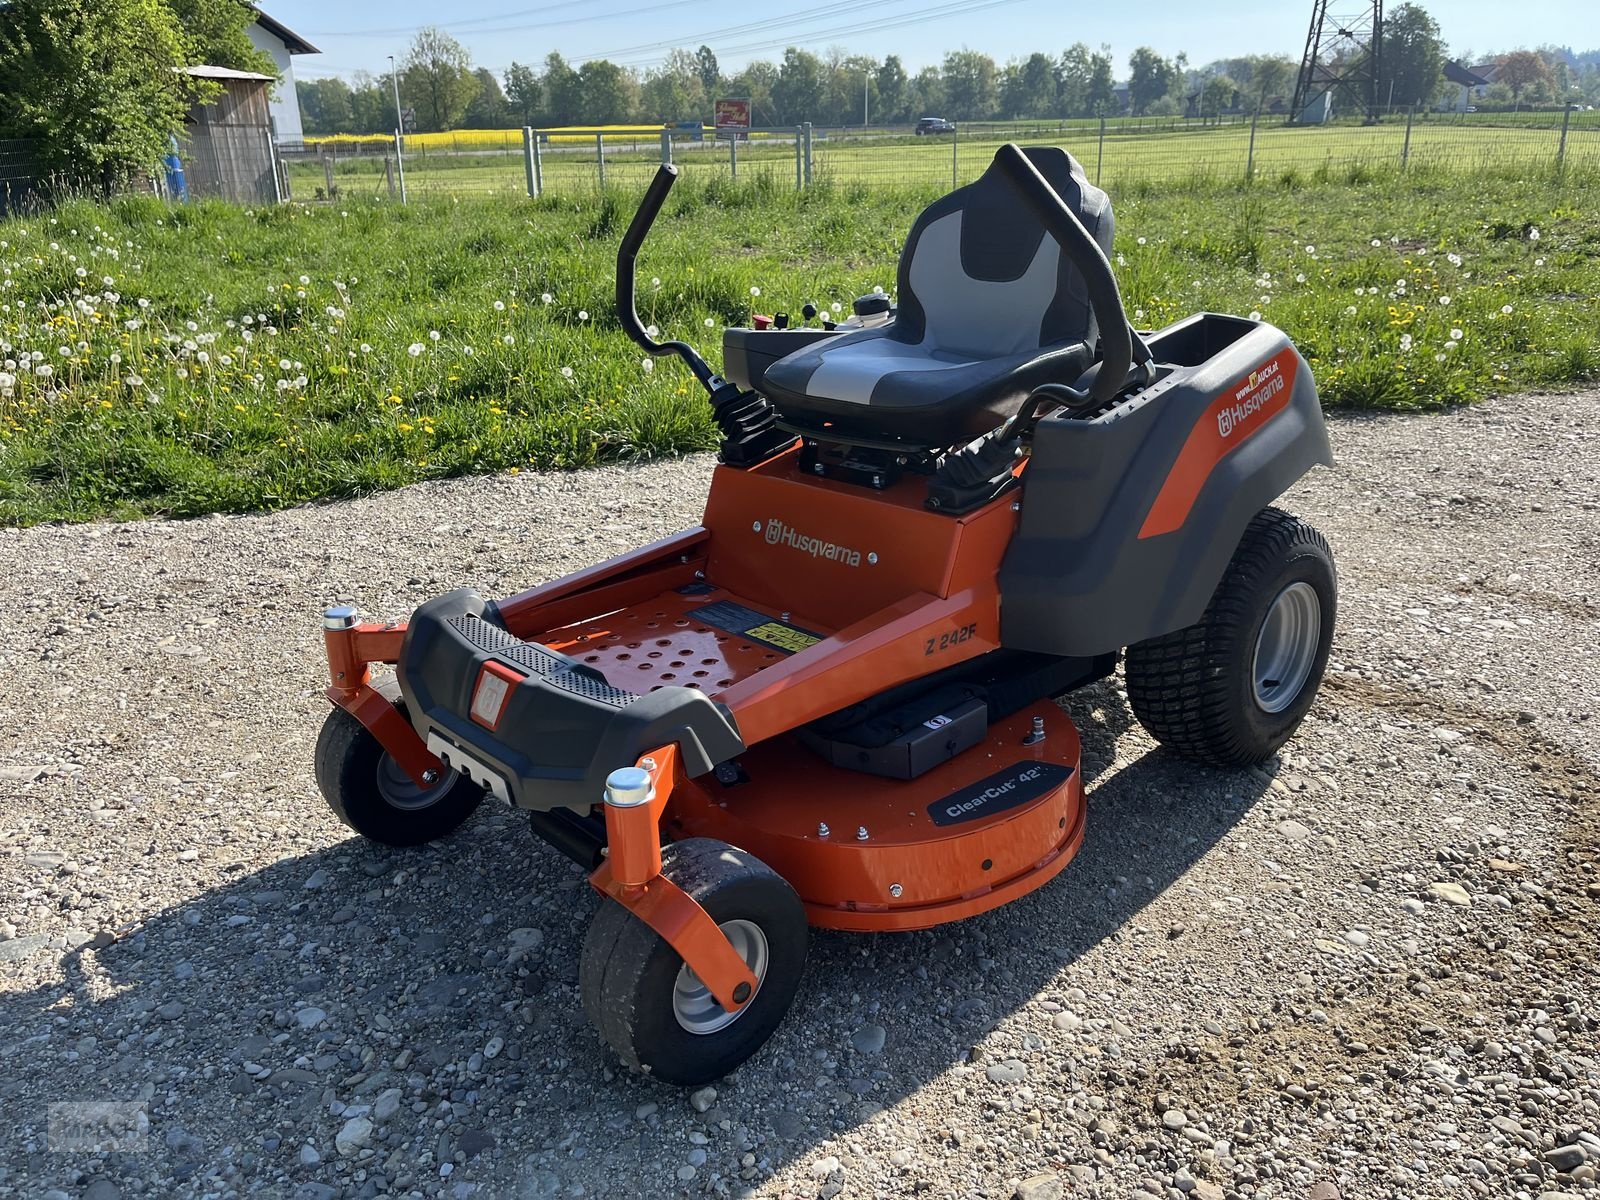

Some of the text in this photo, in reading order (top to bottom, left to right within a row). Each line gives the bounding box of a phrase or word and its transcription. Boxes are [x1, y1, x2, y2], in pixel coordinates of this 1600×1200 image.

[1231, 375, 1284, 426] Husqvarna
[780, 526, 861, 567] Husqvarna
[925, 623, 977, 656] Z 242F
